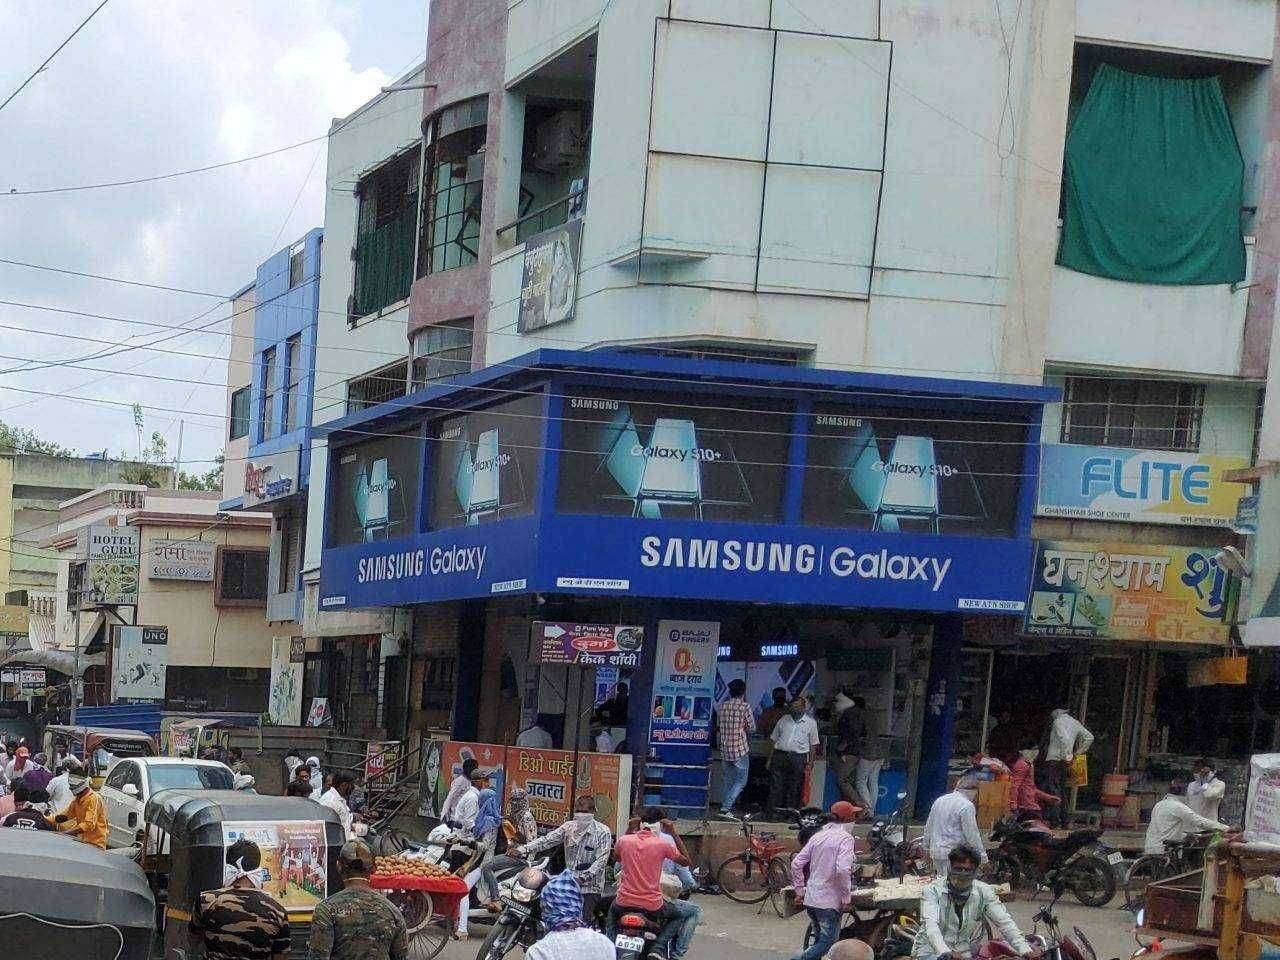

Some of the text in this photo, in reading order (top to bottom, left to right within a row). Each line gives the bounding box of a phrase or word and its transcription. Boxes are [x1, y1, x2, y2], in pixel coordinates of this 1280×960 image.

[570, 398, 619, 411] SAMSUNG
[816, 415, 862, 428] SAMSUNG
[630, 444, 688, 462] Galaxy
[871, 461, 927, 478] Galaxy
[1081, 456, 1210, 504] FLITE
[93, 535, 136, 545] HOTEL
[357, 543, 487, 584] SAMSUNG Galaxy
[640, 535, 951, 591] SAMSUNG Galaxy
[144, 632, 167, 640] UNO
[761, 644, 798, 656] SAMSUNG
[526, 781, 565, 800] जनरल
